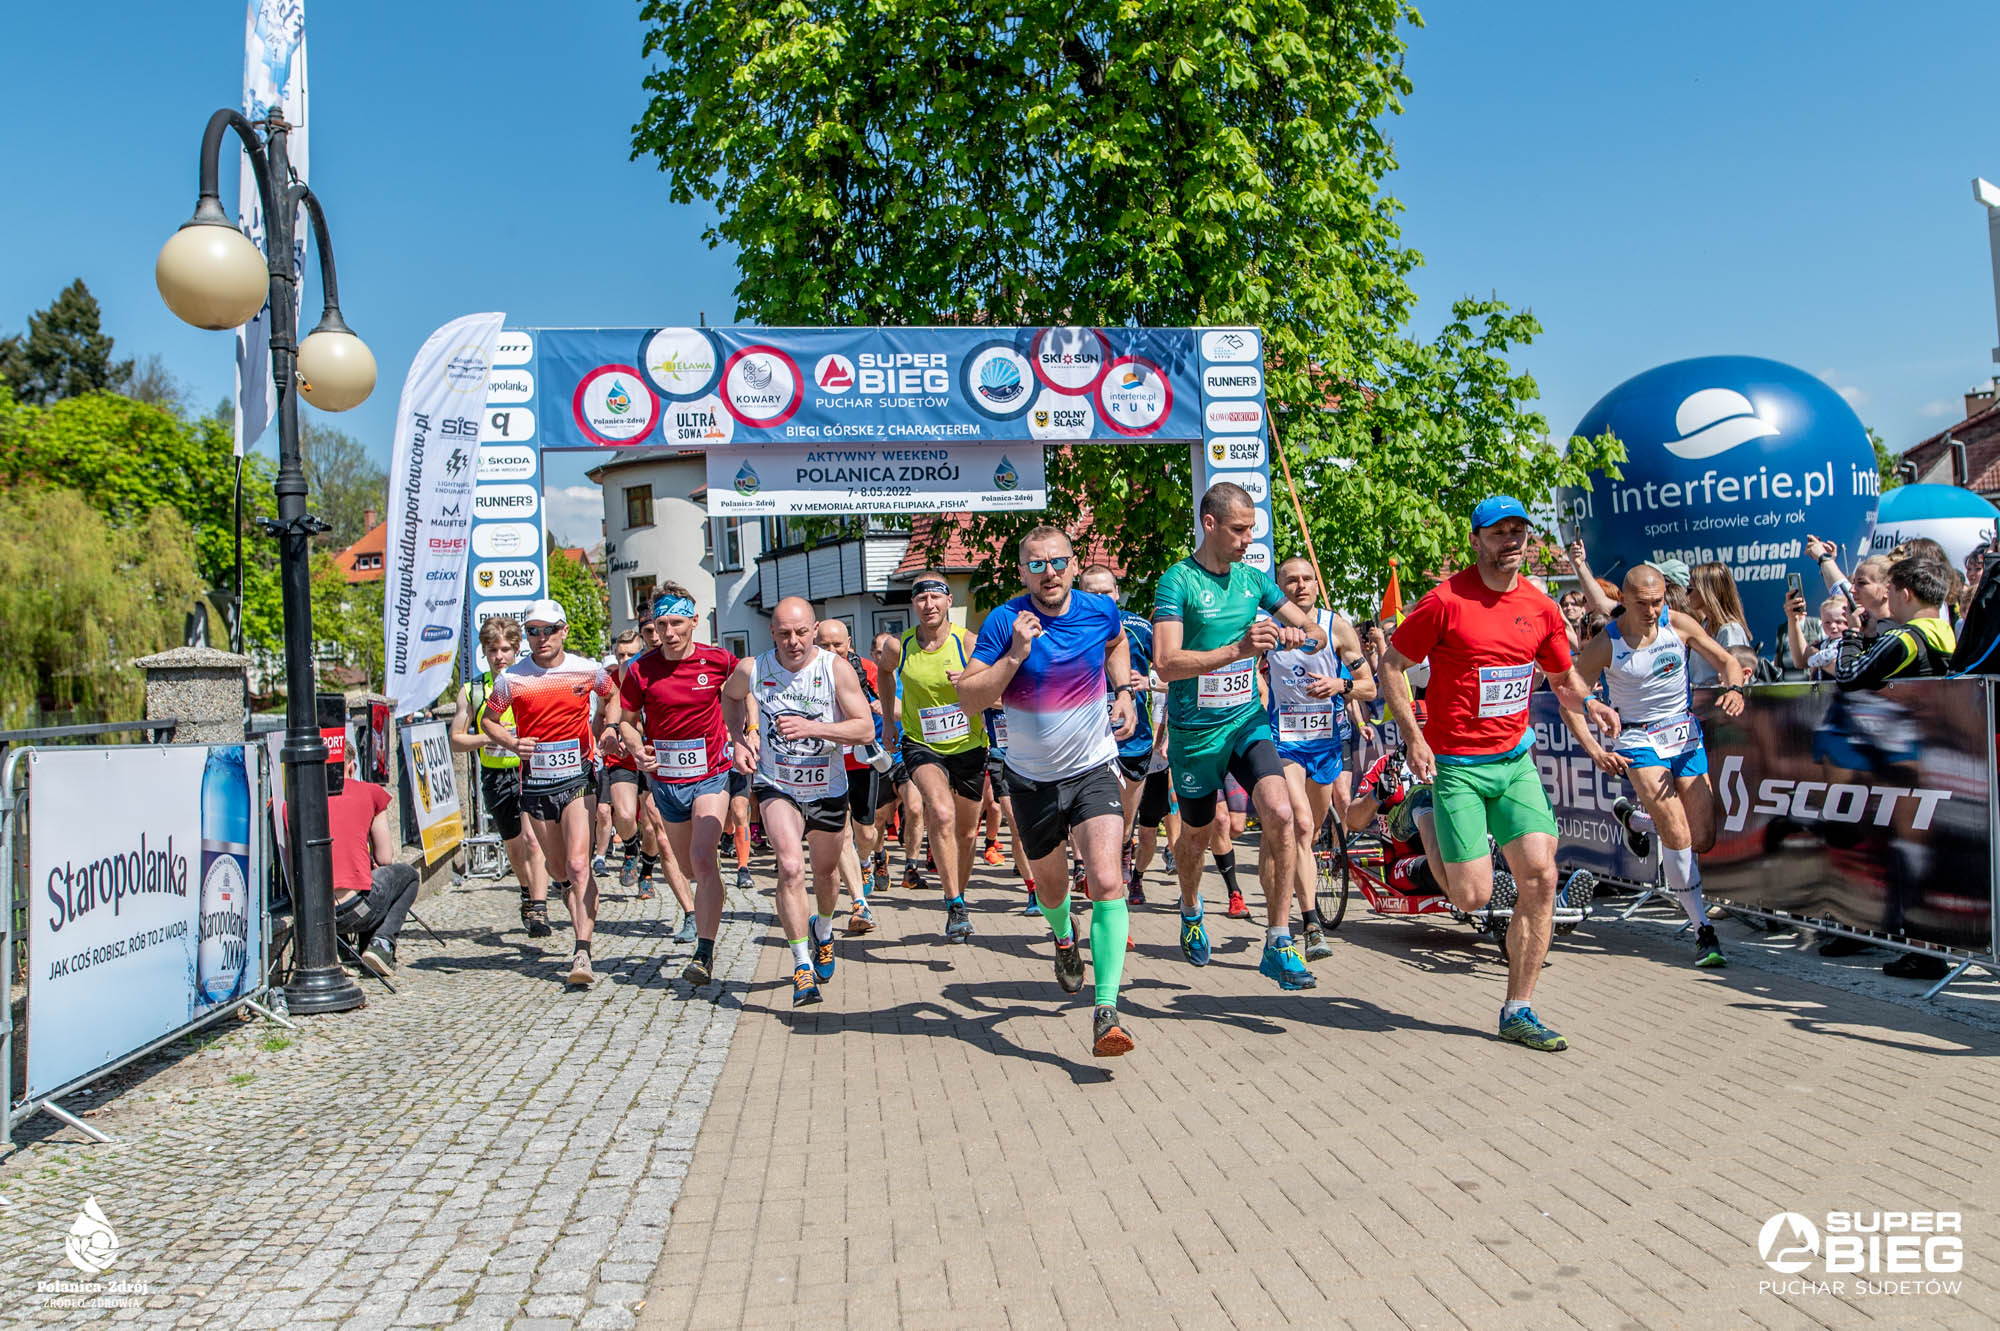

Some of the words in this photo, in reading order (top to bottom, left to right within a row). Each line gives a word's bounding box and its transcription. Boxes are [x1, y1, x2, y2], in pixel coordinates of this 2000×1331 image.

[859, 354, 947, 367] SUPER
[1042, 354, 1061, 363] SKI
[1074, 354, 1099, 363] SUN
[666, 362, 712, 370] BIELAWA
[488, 380, 528, 392] opolanka
[859, 369, 949, 394] BIEG
[736, 395, 781, 403] KOWARY
[816, 398, 873, 408] PUCHAR
[879, 397, 949, 408] SUDETÓW
[1110, 392, 1156, 400] interferie.pl
[676, 413, 716, 427] ULTRA
[1053, 410, 1086, 419] DOLNY
[1053, 418, 1085, 428] ŚLĄSK
[678, 429, 702, 439] SOWA
[786, 426, 820, 437] BIEGI
[823, 423, 874, 436] GÓRSKE
[877, 425, 885, 436] Z
[888, 424, 980, 436] CHARAKTEREM
[1230, 443, 1260, 452] DOLNY
[807, 451, 876, 462] AKTYWNY
[882, 450, 948, 461] WEEKEND
[1230, 451, 1259, 460] ŚLĄSK
[796, 467, 896, 483] POLANICA
[899, 463, 960, 482] ZDRÓJ
[861, 486, 912, 497] 8.05.2022
[1612, 462, 1834, 514] interferie.pl
[476, 496, 533, 507] RUNNER'S
[720, 499, 776, 508] Polanica-Zdrój
[981, 494, 1033, 502] Polanica-Zdrój
[790, 503, 803, 511] XV
[804, 502, 853, 511] MEMORIAŁ
[854, 502, 892, 510] ARTURA
[892, 501, 935, 510] FILIPIAKA
[1644, 521, 1679, 537] sport
[1684, 520, 1688, 531] i
[1692, 512, 1749, 531] zdrowie
[1754, 511, 1781, 528] cały
[1785, 509, 1806, 524] rok
[1717, 546, 1734, 563] w
[1737, 539, 1801, 565] górach
[426, 568, 457, 580] etixx
[499, 569, 535, 578] DOLNY
[499, 577, 533, 588] ŚLĄSK
[1223, 673, 1249, 692] 358
[1503, 679, 1529, 700] 234
[940, 712, 965, 730] 172
[1300, 715, 1328, 729] 154
[323, 736, 344, 748] PORT
[424, 735, 451, 767] DOLNY
[548, 751, 576, 767] 335
[678, 752, 697, 765] 68
[794, 768, 825, 782] 216
[431, 768, 454, 804] ŚLĄSK
[1535, 755, 1622, 812] BIEG
[1754, 780, 1953, 830] SCOTT
[1556, 816, 1624, 846] SUDETÓW
[48, 832, 187, 932] Staropolanka
[199, 901, 248, 944] Staropolanka
[49, 959, 69, 980] JAK
[71, 947, 90, 972] COŚ
[93, 941, 127, 966] ROBISZ,
[129, 931, 145, 953] RÓB
[147, 930, 157, 946] TO
[159, 927, 164, 943] Z
[221, 940, 243, 970] 2000
